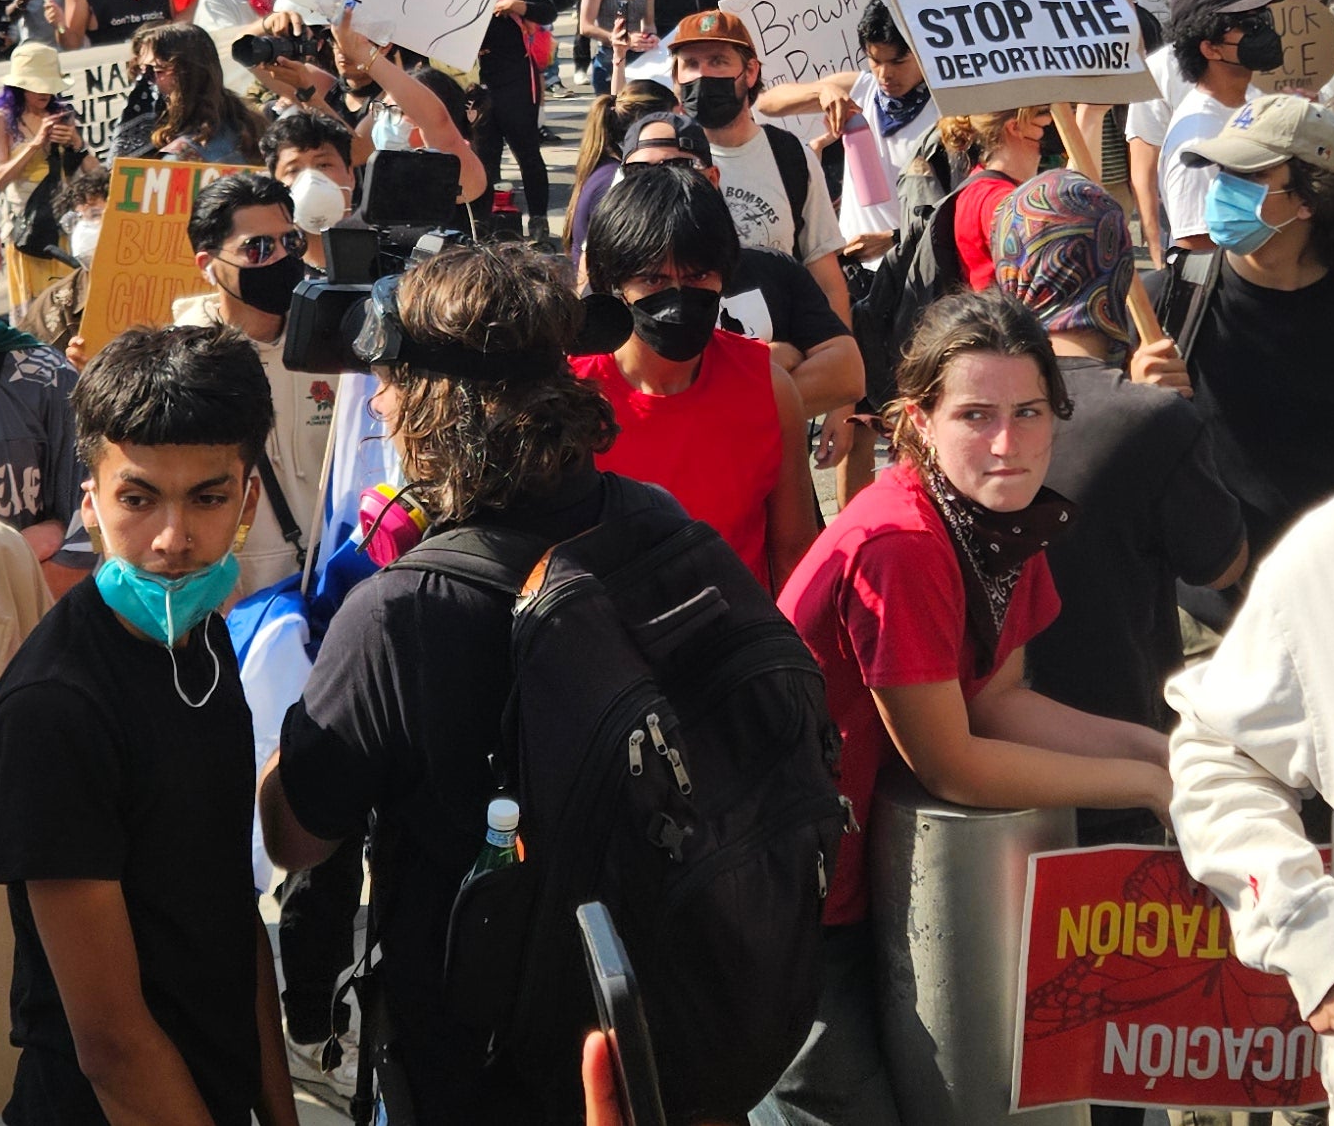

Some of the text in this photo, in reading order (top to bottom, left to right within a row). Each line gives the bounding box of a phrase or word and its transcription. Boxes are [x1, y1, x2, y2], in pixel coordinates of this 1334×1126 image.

[918, 0, 1033, 50] STOP
[1267, 5, 1321, 38] UCK
[933, 41, 1130, 81] DEPORTATIONS!
[725, 185, 779, 225] BOMBERS
[1057, 902, 1236, 968] TACIÓN
[1103, 1022, 1321, 1090] UCACIÓN
